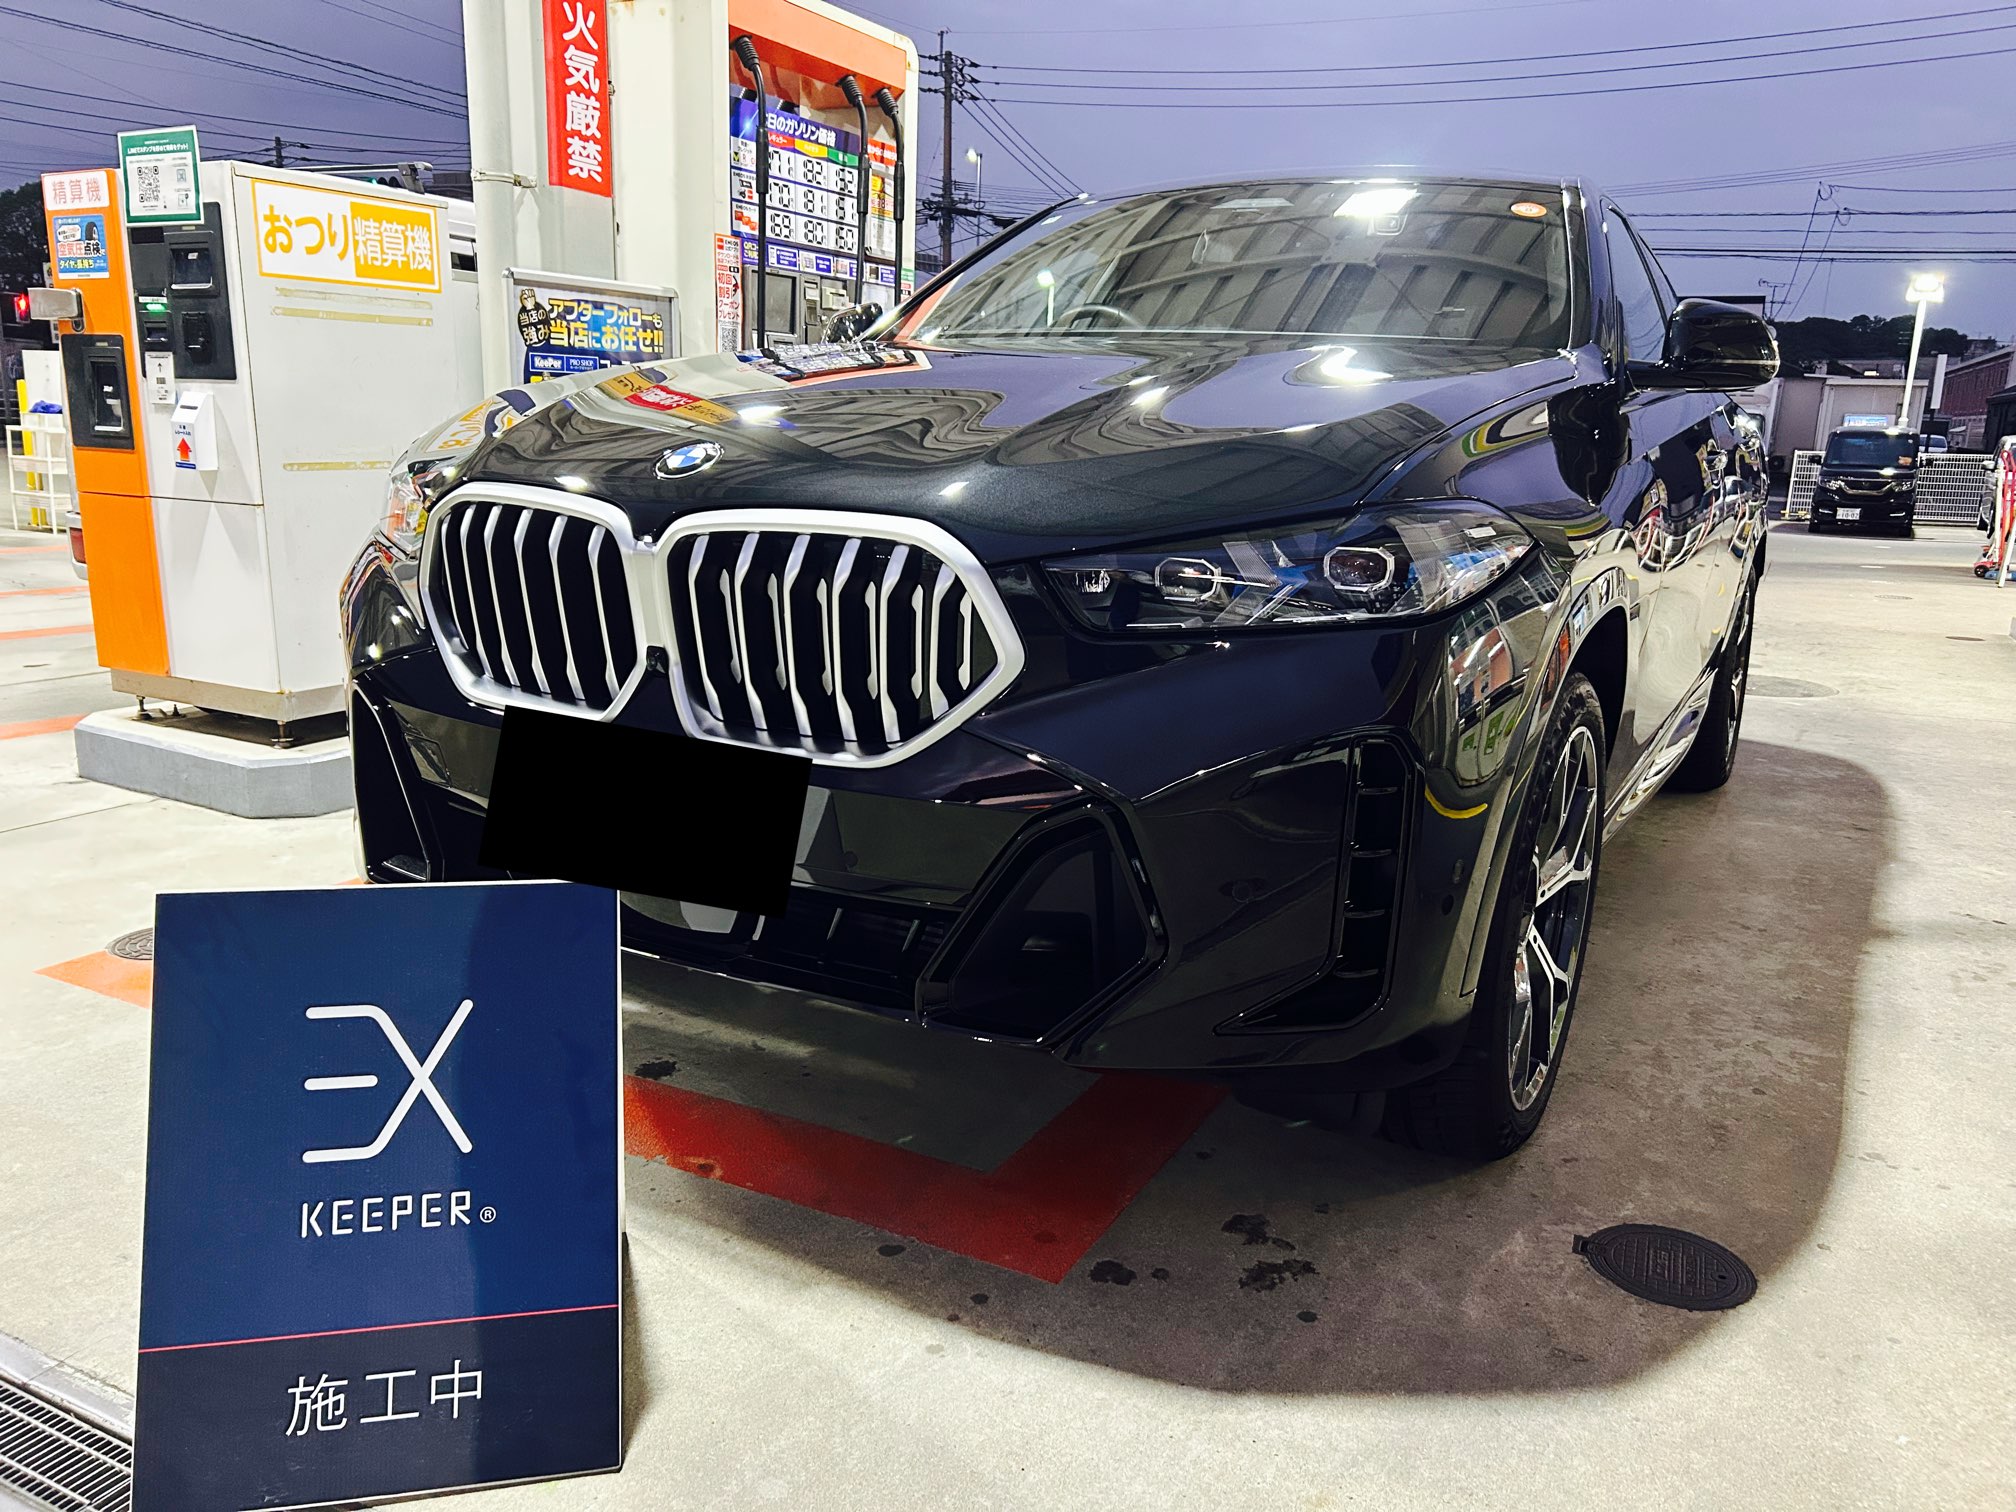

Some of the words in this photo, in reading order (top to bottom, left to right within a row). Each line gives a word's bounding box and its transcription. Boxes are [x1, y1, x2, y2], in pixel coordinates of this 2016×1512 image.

[562, 1, 603, 184] 火気厳禁
[765, 112, 836, 147] 日のガソリン価格
[52, 177, 102, 205] 精算機
[519, 308, 547, 326] 当店の
[549, 299, 663, 329] アフターフォローも
[523, 324, 550, 345] 強み
[534, 356, 562, 369] KeePer
[284, 1359, 484, 1438] 施工中
